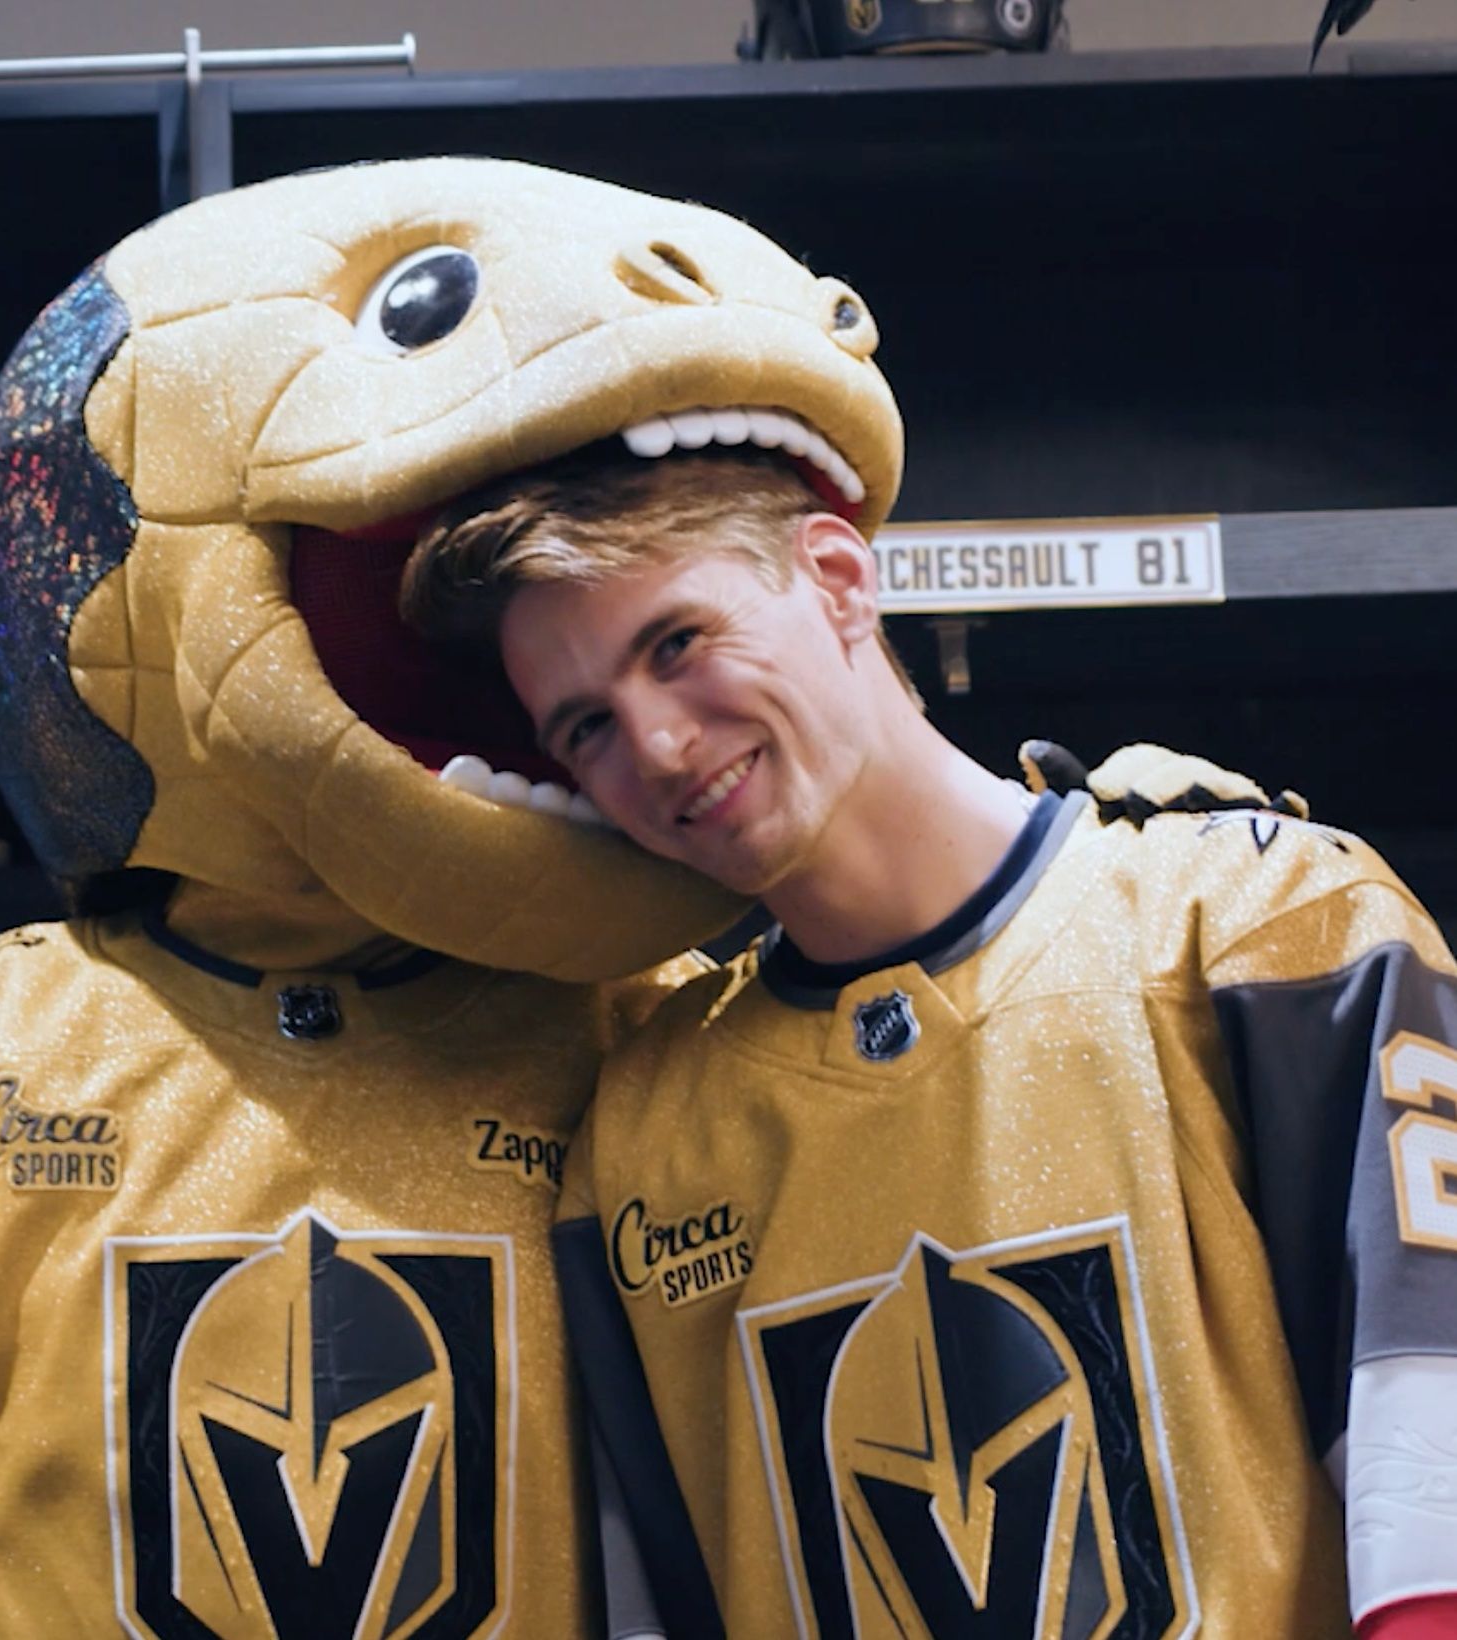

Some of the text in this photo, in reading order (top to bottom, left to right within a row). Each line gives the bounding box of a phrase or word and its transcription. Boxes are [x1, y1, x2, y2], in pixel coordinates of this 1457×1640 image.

[1137, 538, 1190, 586] 81
[13, 1152, 116, 1187] SPORTS
[474, 1119, 567, 1181] Zapp
[1379, 1029, 1457, 1251] 2
[612, 1199, 744, 1291] Circa
[663, 1240, 754, 1303] SPORTS
